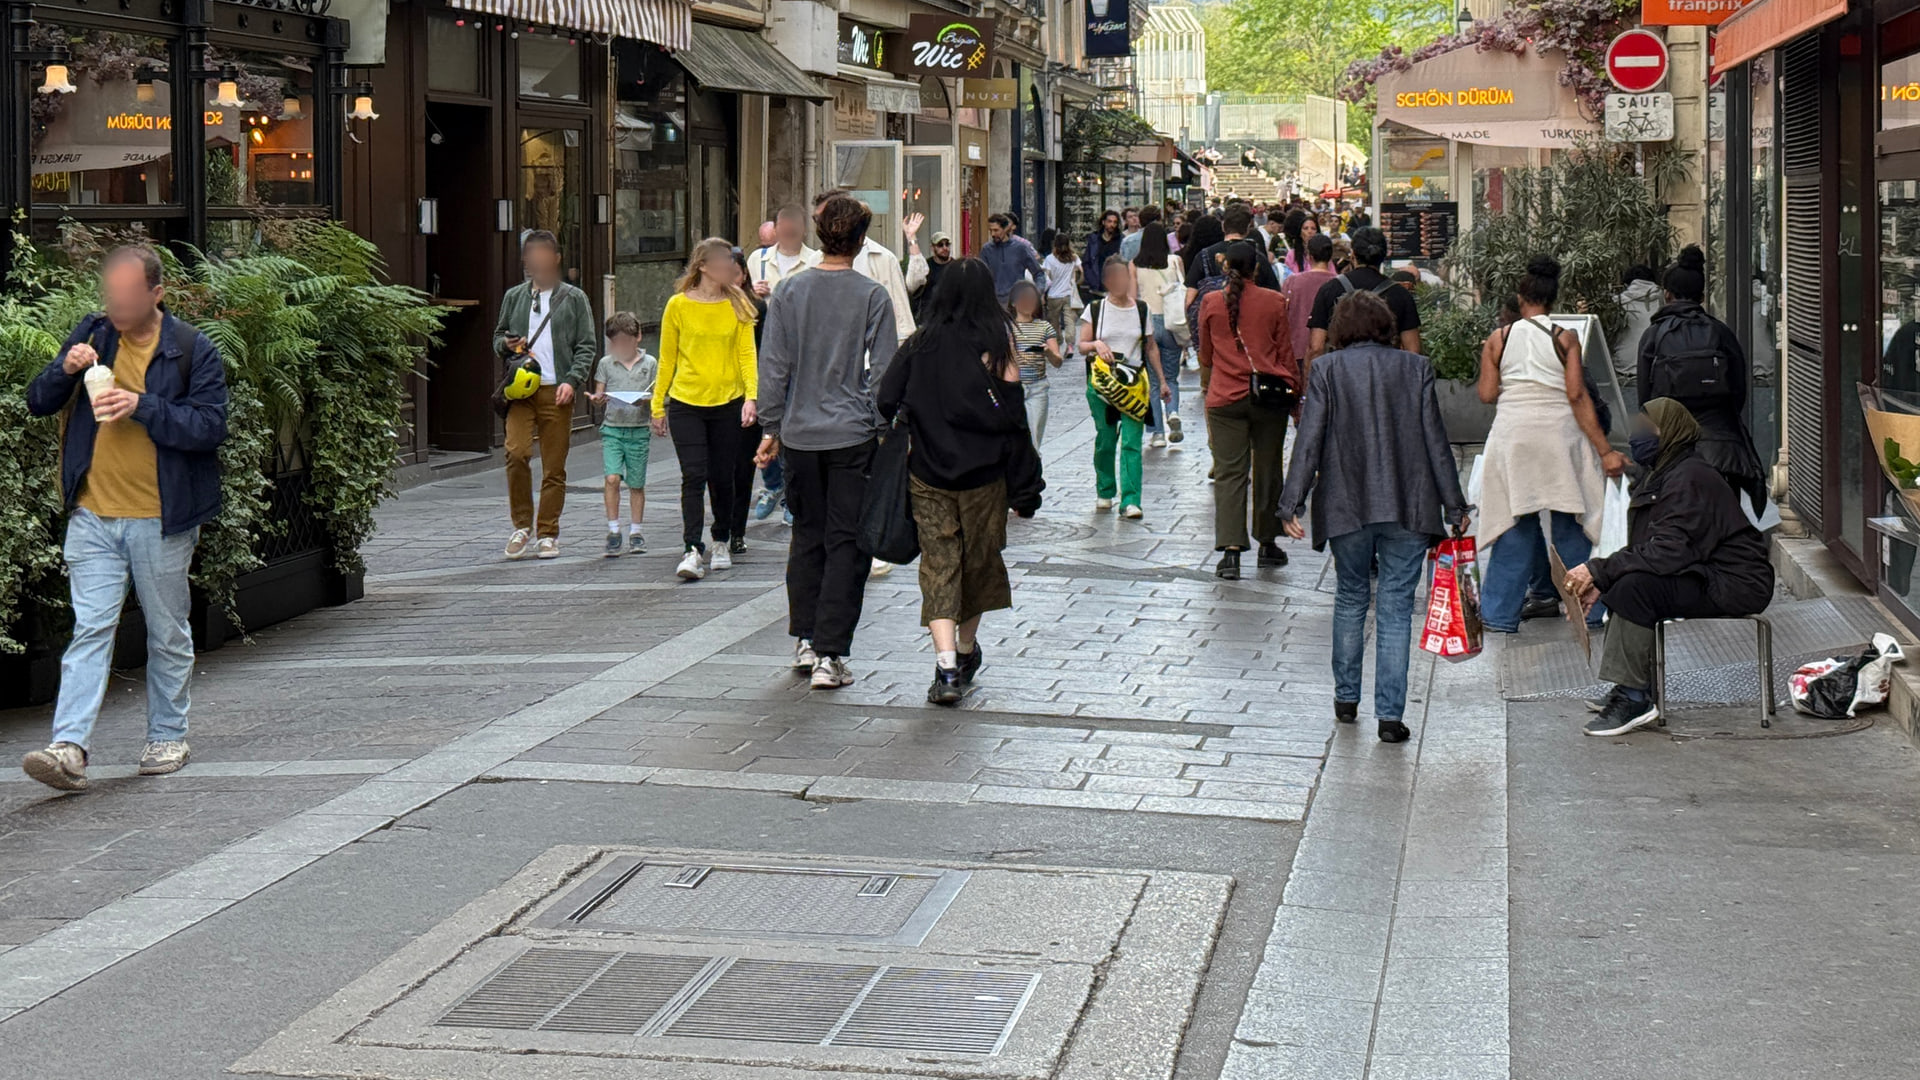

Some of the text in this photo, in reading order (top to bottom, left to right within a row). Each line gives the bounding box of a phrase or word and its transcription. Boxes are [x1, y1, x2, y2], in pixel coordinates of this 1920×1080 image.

[1669, 0, 1743, 14] franprix
[912, 41, 964, 69] Wic
[965, 92, 1012, 101] NUXE
[1396, 86, 1514, 108] SCHÖN DÜRÜM
[1617, 96, 1660, 108] SAUF
[1452, 130, 1490, 139] MADE
[1540, 129, 1593, 140] TURKISH
